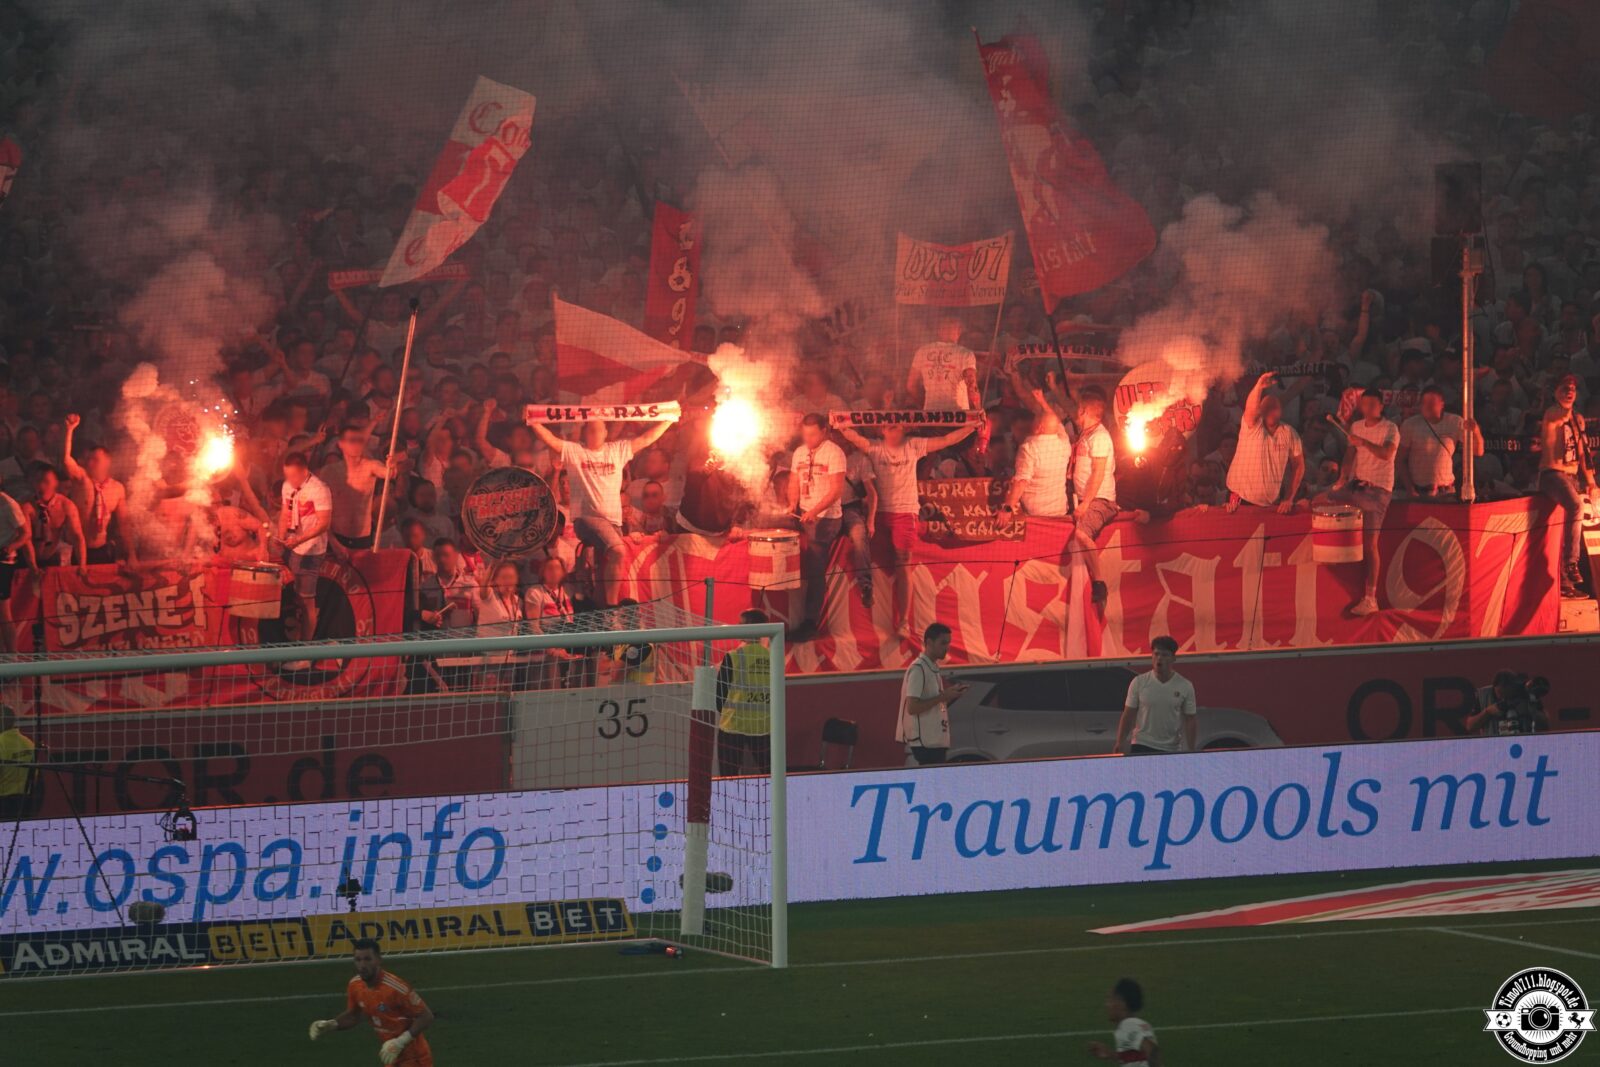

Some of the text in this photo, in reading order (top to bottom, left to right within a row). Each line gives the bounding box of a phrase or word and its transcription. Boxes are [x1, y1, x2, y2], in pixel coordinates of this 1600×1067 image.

[851, 411, 966, 425] COMMANDO
[57, 584, 184, 647] SZENE
[597, 699, 649, 740] 35
[851, 744, 1559, 871] Traumpools mit
[13, 932, 205, 971] ADMIRAL
[326, 908, 521, 949] ADMIRAL
[534, 905, 621, 931] BET
